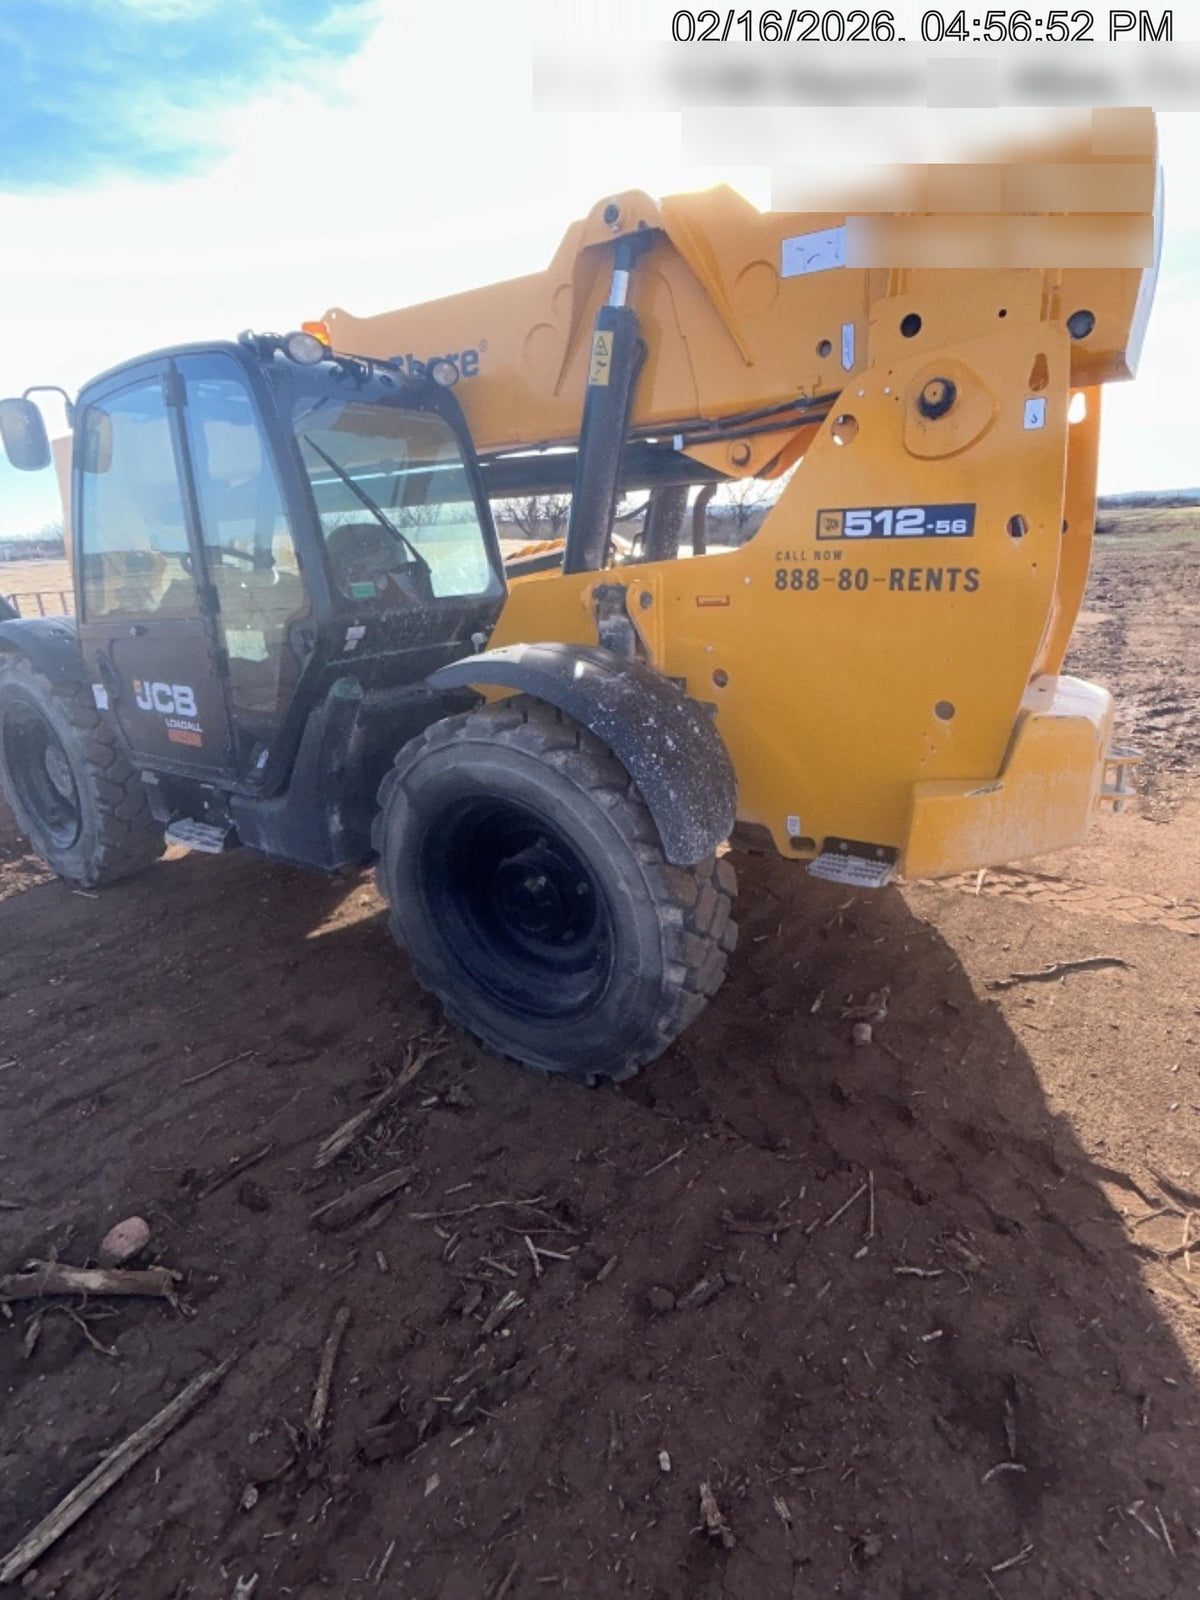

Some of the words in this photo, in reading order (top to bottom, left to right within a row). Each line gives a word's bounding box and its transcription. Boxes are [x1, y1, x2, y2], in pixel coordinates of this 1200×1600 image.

[774, 551, 807, 562] CALL
[813, 550, 844, 561] NOW
[774, 568, 980, 592] 888-80-RENTS
[135, 680, 198, 717] JCB
